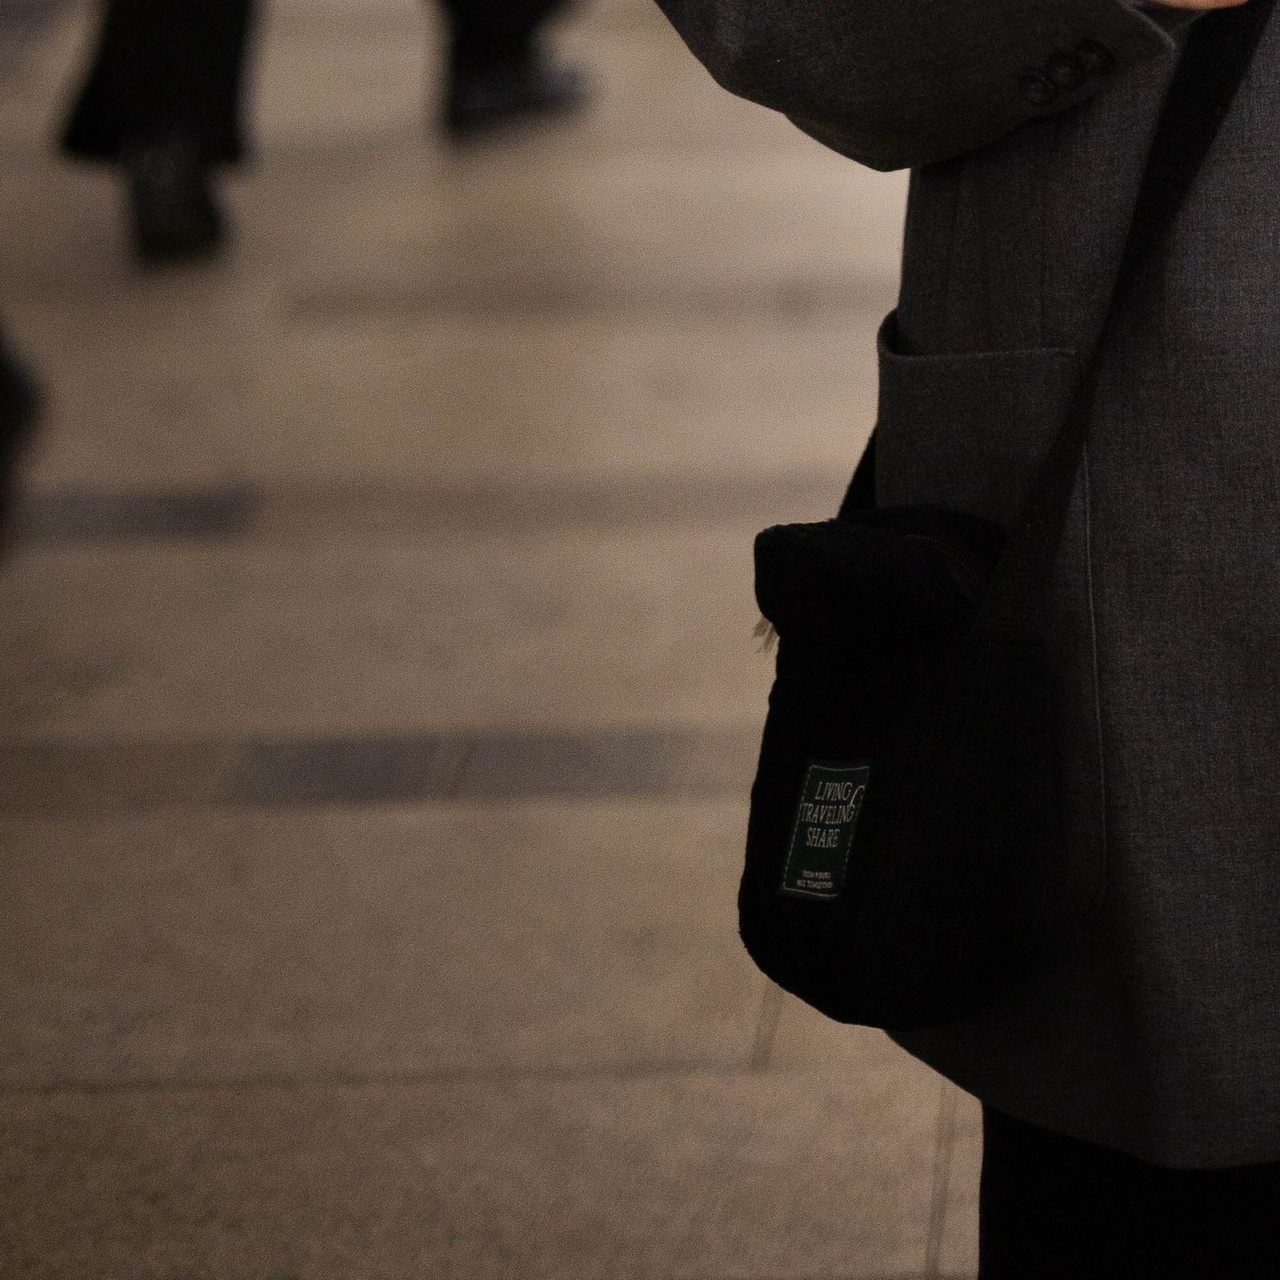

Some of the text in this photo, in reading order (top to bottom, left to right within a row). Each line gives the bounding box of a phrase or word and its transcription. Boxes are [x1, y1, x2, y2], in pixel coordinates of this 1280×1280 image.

[814, 781, 853, 801] LIVING
[801, 802, 856, 824] TRAVELING
[806, 827, 841, 848] SHARE
